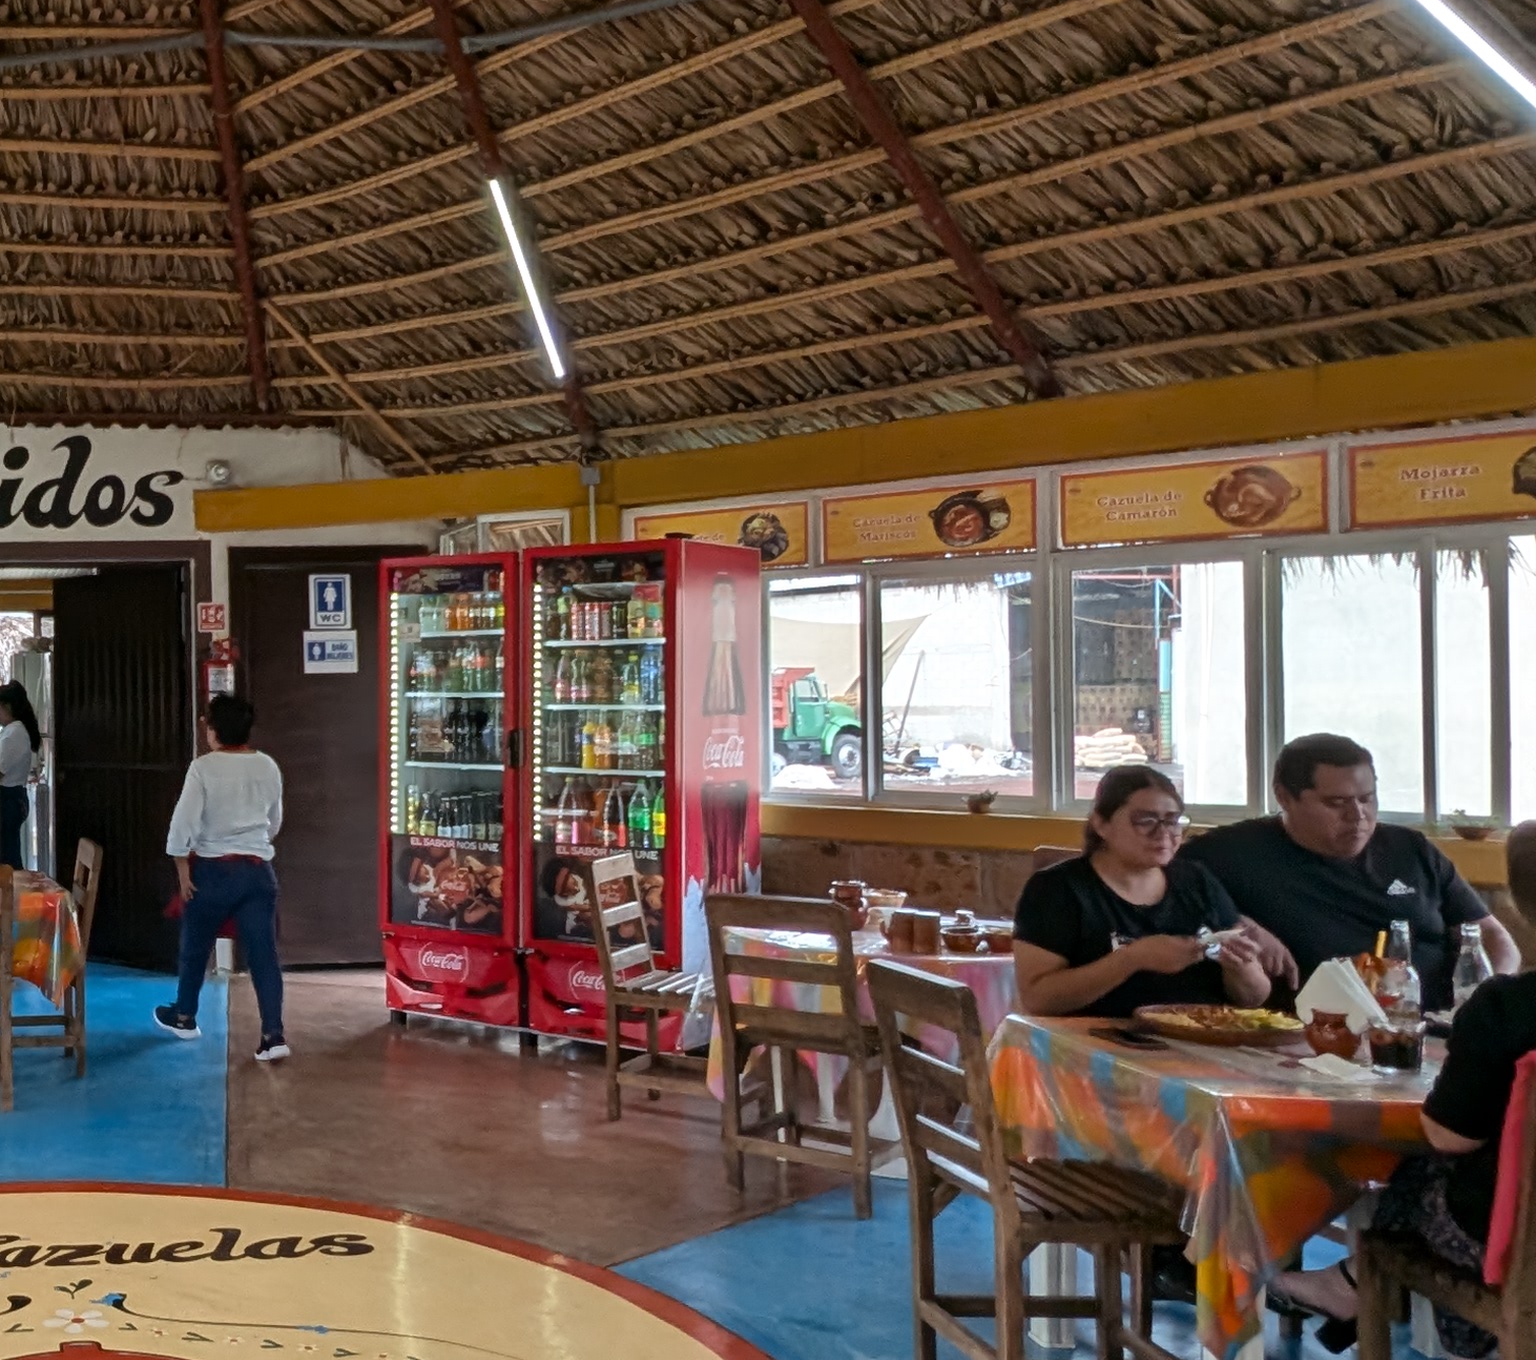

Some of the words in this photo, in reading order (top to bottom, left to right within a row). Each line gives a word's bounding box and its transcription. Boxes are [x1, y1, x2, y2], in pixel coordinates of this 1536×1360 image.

[1400, 467, 1481, 481] Mojarra
[1096, 493, 1159, 507] Cazuela
[1163, 490, 1182, 501] de
[1420, 486, 1466, 500] Frita
[1105, 507, 1177, 521] Camarón
[320, 614, 341, 623] WC
[410, 836, 422, 846] EL
[424, 838, 455, 848] SABOR
[456, 840, 477, 850] NOS
[478, 842, 499, 852] UNE
[556, 845, 569, 855] EL
[571, 846, 607, 857] SABOR
[634, 849, 658, 860] UNE
